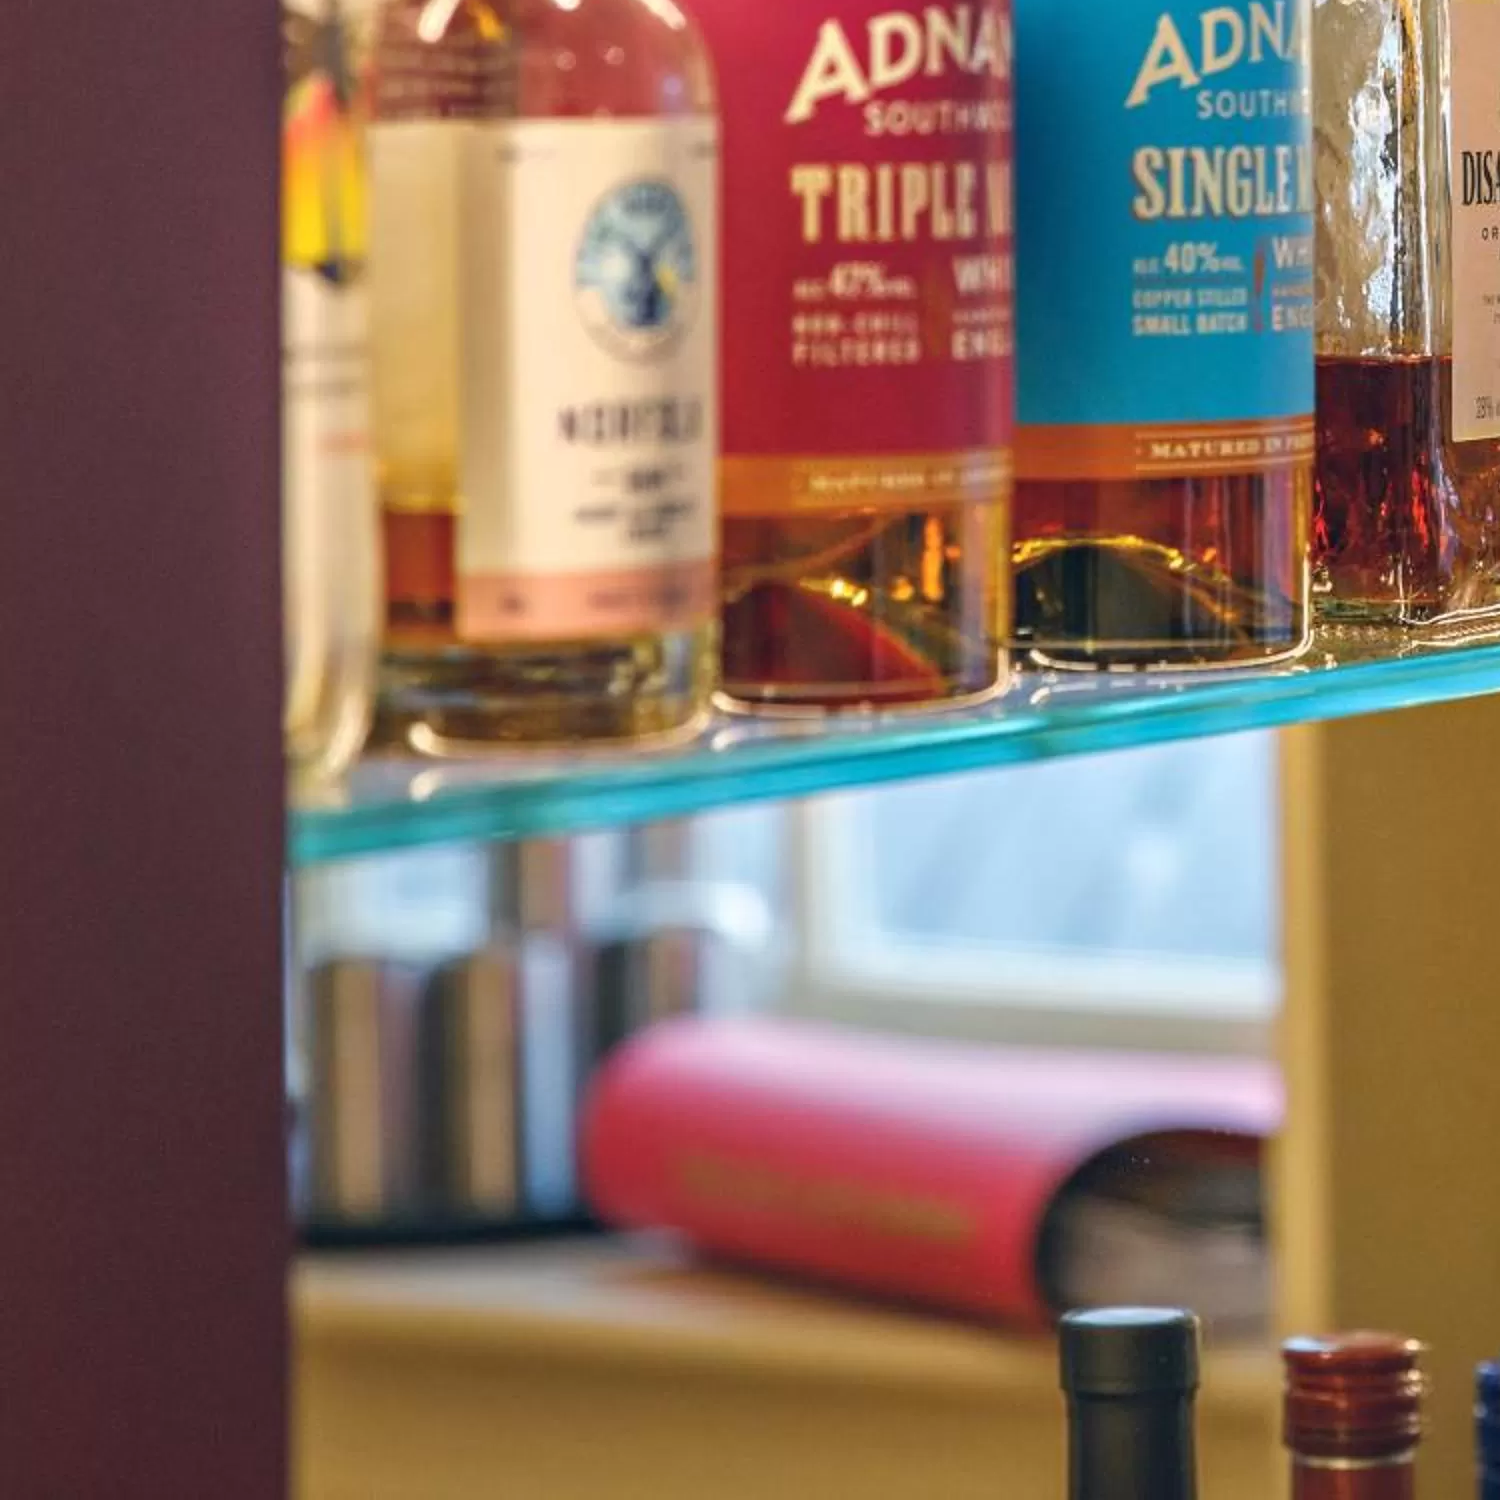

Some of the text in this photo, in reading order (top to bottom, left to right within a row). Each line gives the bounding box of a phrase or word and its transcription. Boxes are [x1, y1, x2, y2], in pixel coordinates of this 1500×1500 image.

[790, 163, 977, 243] TRIPLE
[1133, 145, 1291, 219] SINGLE
[1132, 313, 1191, 337] SMALL
[1151, 438, 1261, 459] MATURED
